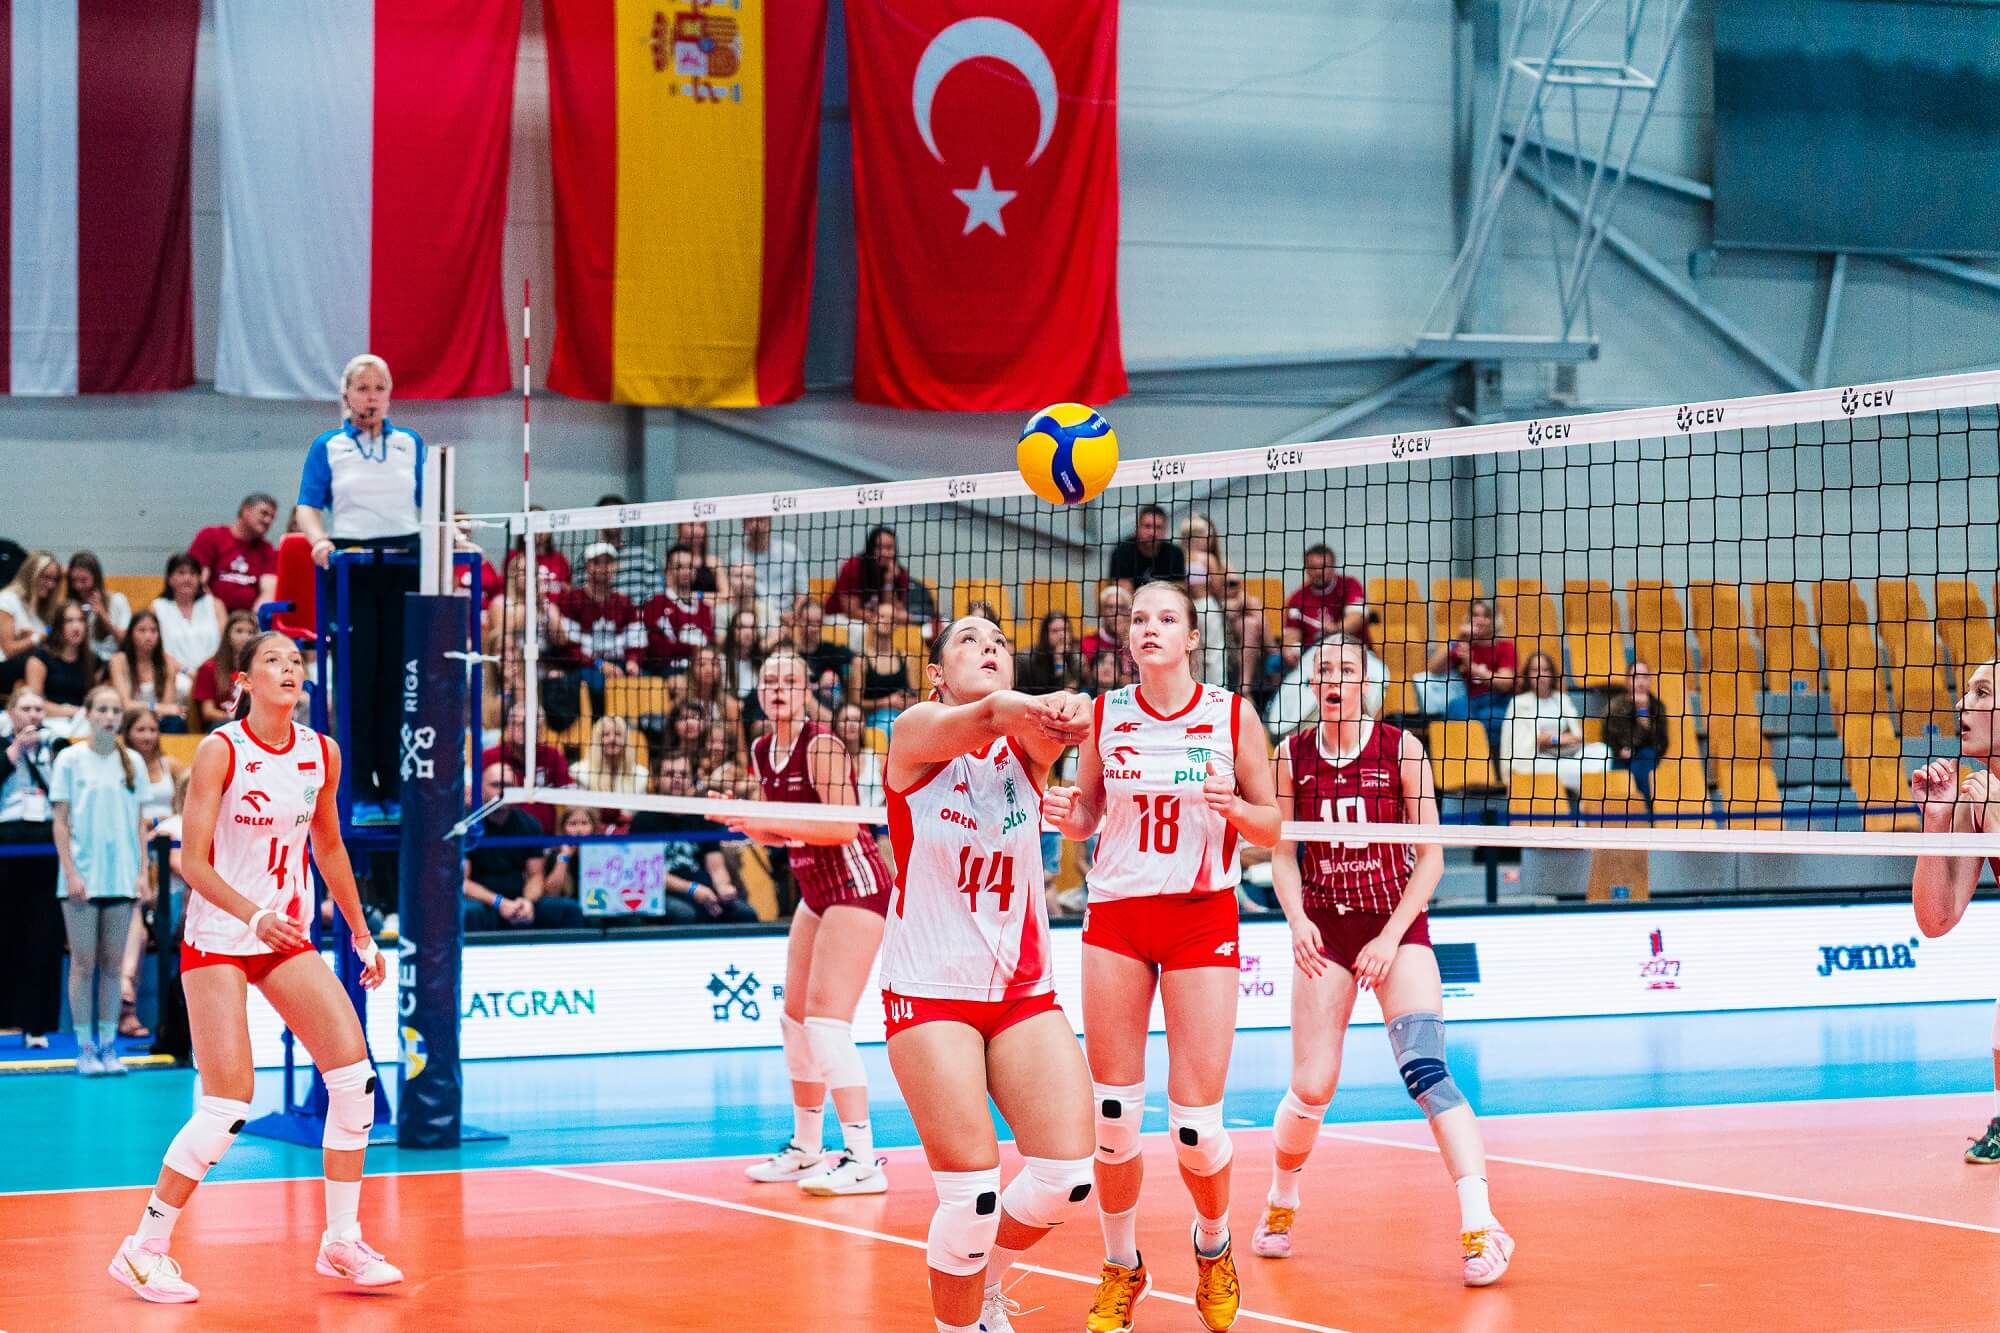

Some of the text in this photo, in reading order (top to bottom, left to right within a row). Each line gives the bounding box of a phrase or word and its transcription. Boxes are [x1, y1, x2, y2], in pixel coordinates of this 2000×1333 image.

[1862, 390, 1893, 407] CEV
[1696, 407, 1725, 424] CEV
[1545, 424, 1571, 439] CEV
[1407, 437, 1431, 452] CEV
[1282, 450, 1303, 465] CEV
[1166, 461, 1186, 475] CEV
[868, 488, 885, 502] CEV
[960, 481, 978, 494] CEV
[1174, 768, 1207, 784] plu
[234, 814, 273, 826] ORLEN
[1133, 794, 1180, 854] 18
[268, 837, 289, 890] 4
[958, 846, 1015, 912] 44
[1214, 941, 1236, 956] 4F
[399, 935, 417, 1018] CEV
[463, 988, 596, 1018] ATGRAN
[890, 997, 914, 1024] 44
